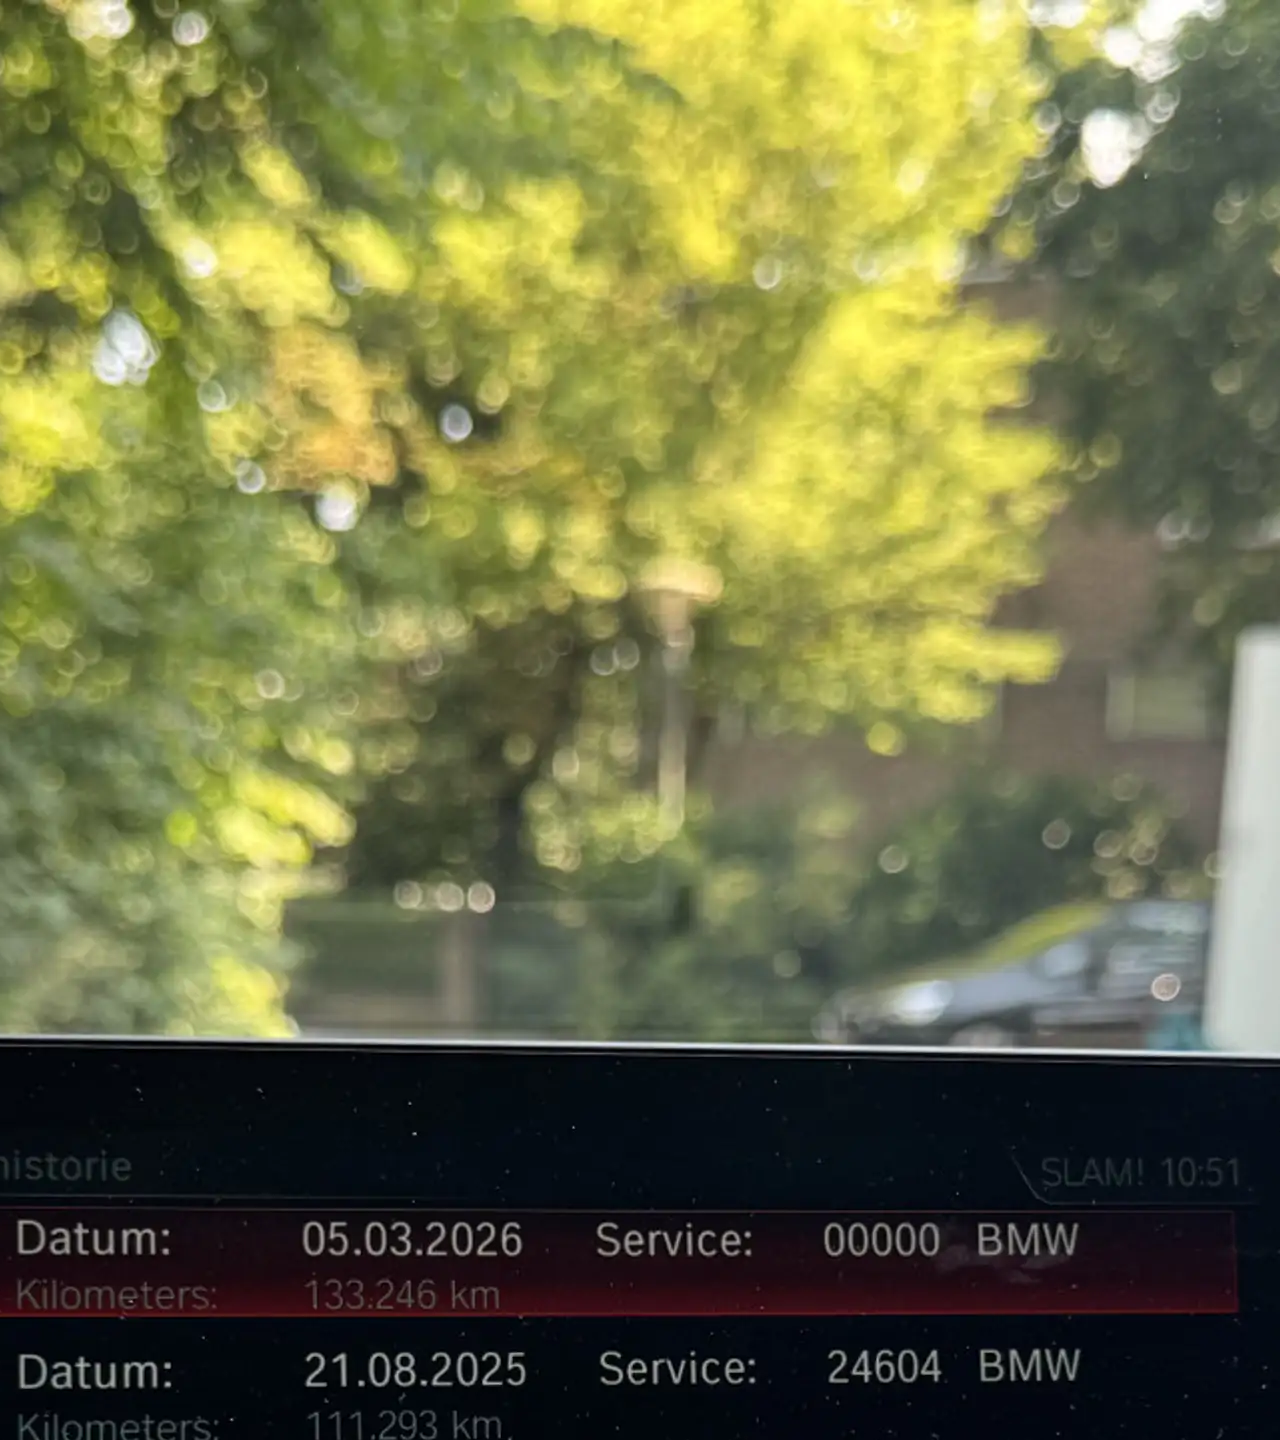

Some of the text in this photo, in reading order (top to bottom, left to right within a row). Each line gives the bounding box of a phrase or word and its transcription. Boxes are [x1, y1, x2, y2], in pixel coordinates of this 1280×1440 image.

[1041, 1156, 1239, 1188] SLAM! 10:51
[17, 1219, 170, 1256] Datum:
[302, 1220, 523, 1257] 05.03.2026
[596, 1221, 752, 1257] Service:
[823, 1222, 941, 1257] 00000
[977, 1222, 1079, 1257] BMW
[16, 1278, 500, 1311] Kilometers: 133.246 km
[18, 1353, 172, 1390] Datum:
[305, 1351, 527, 1388] 21.08.2025
[599, 1350, 756, 1386] Service:
[827, 1348, 942, 1384] 24604
[979, 1348, 1081, 1383] BMW
